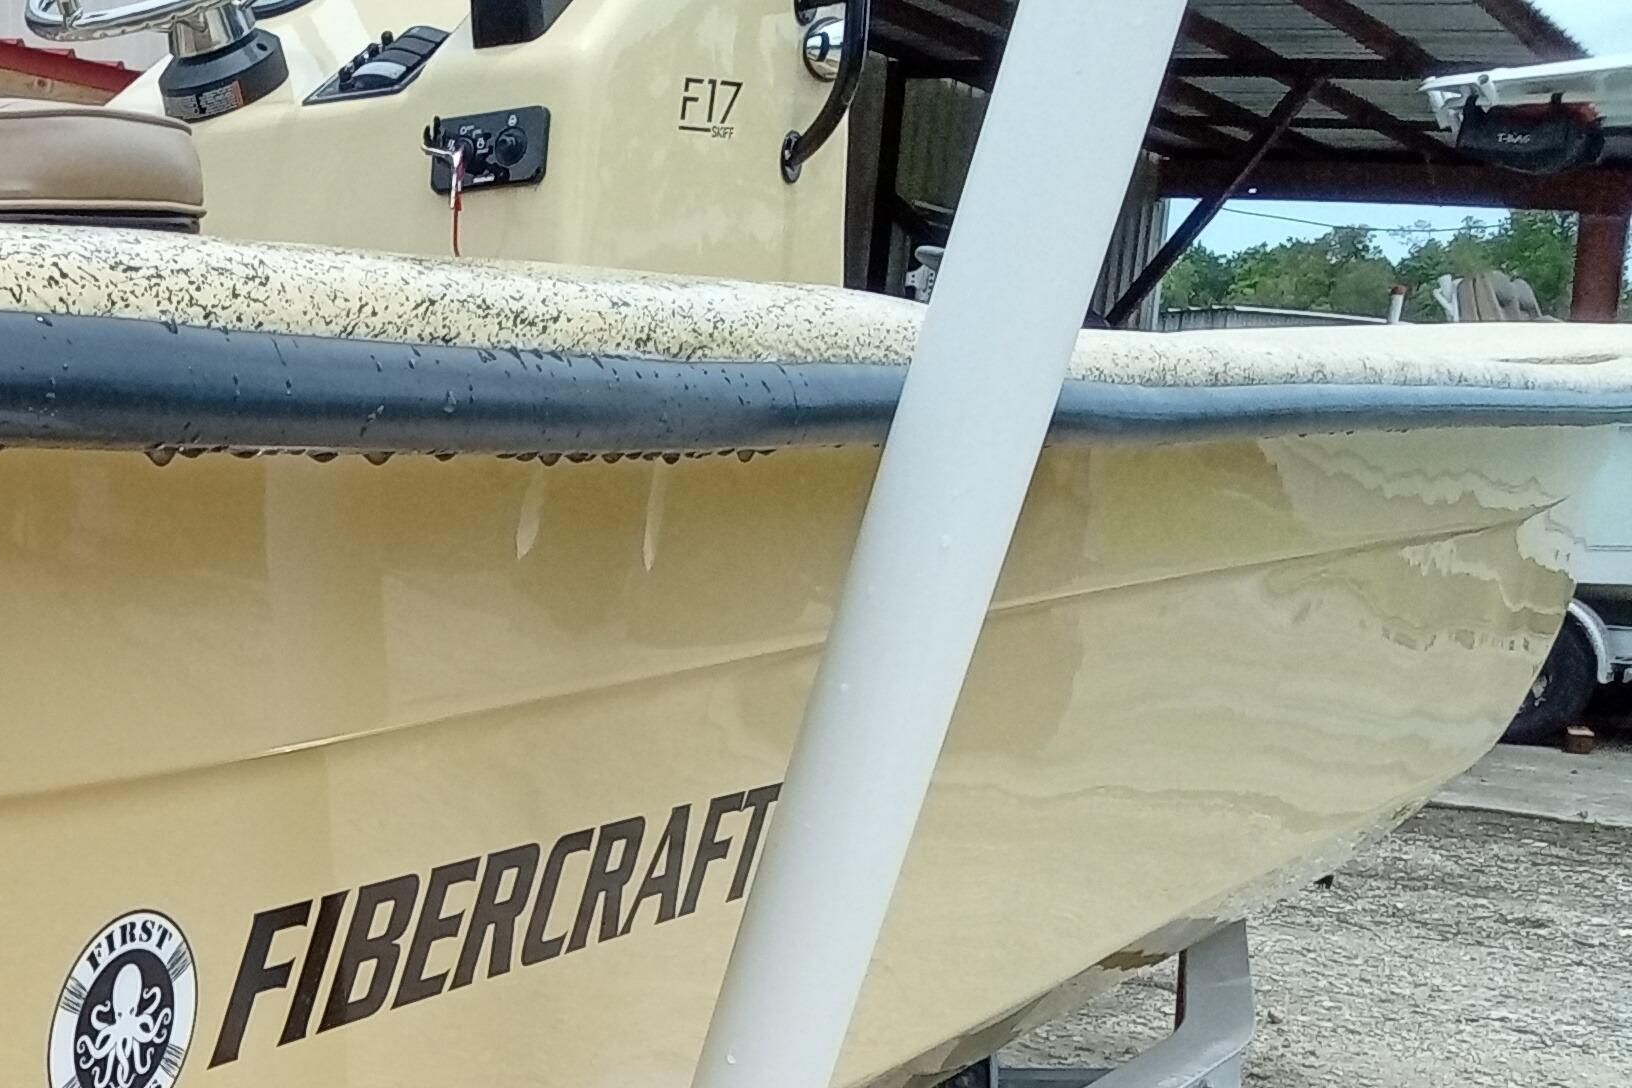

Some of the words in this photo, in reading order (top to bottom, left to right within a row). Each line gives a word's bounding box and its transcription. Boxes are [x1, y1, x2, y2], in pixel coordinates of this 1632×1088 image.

[680, 77, 743, 124] F17
[711, 125, 734, 139] SKIFF
[86, 919, 173, 973] FIRST
[207, 782, 784, 1069] FIBERCRAFT
